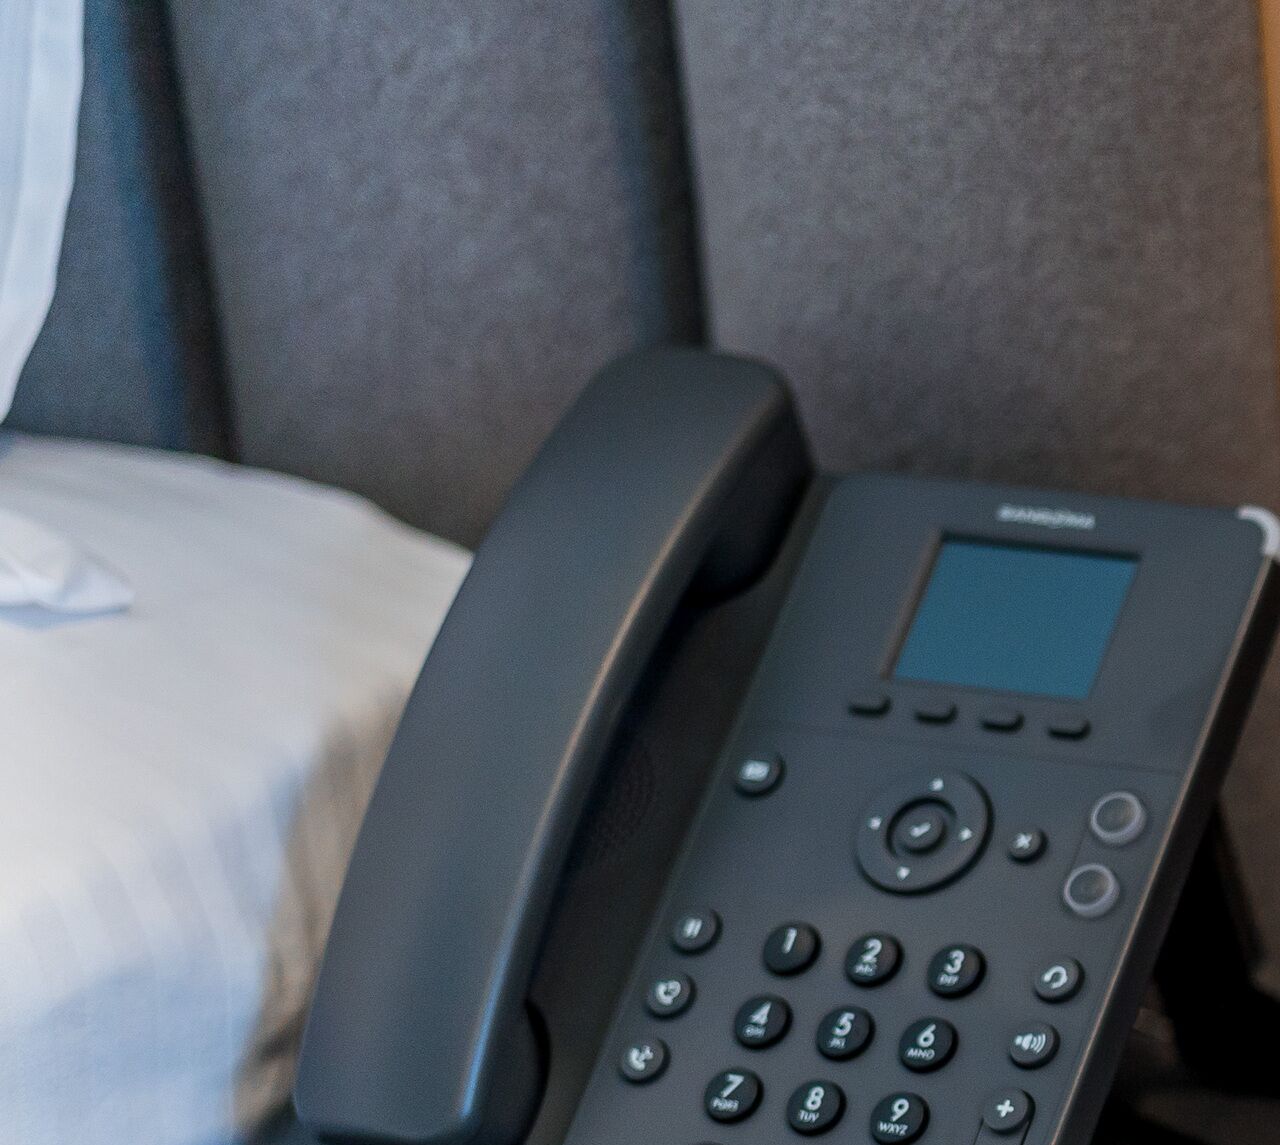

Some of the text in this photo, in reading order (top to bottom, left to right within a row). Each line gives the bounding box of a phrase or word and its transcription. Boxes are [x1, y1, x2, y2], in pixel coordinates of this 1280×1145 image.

[783, 928, 797, 954] 1
[860, 938, 882, 963] 2
[945, 950, 965, 974] 3
[751, 1001, 772, 1025] 4
[835, 1012, 855, 1037] 5
[916, 1023, 936, 1048] 6
[907, 1048, 935, 1060] MNO
[720, 1074, 745, 1098] 7
[806, 1086, 825, 1111] 8
[890, 1098, 910, 1122] 9
[798, 1110, 820, 1123] TUV
[877, 1121, 908, 1135] WXYZ
